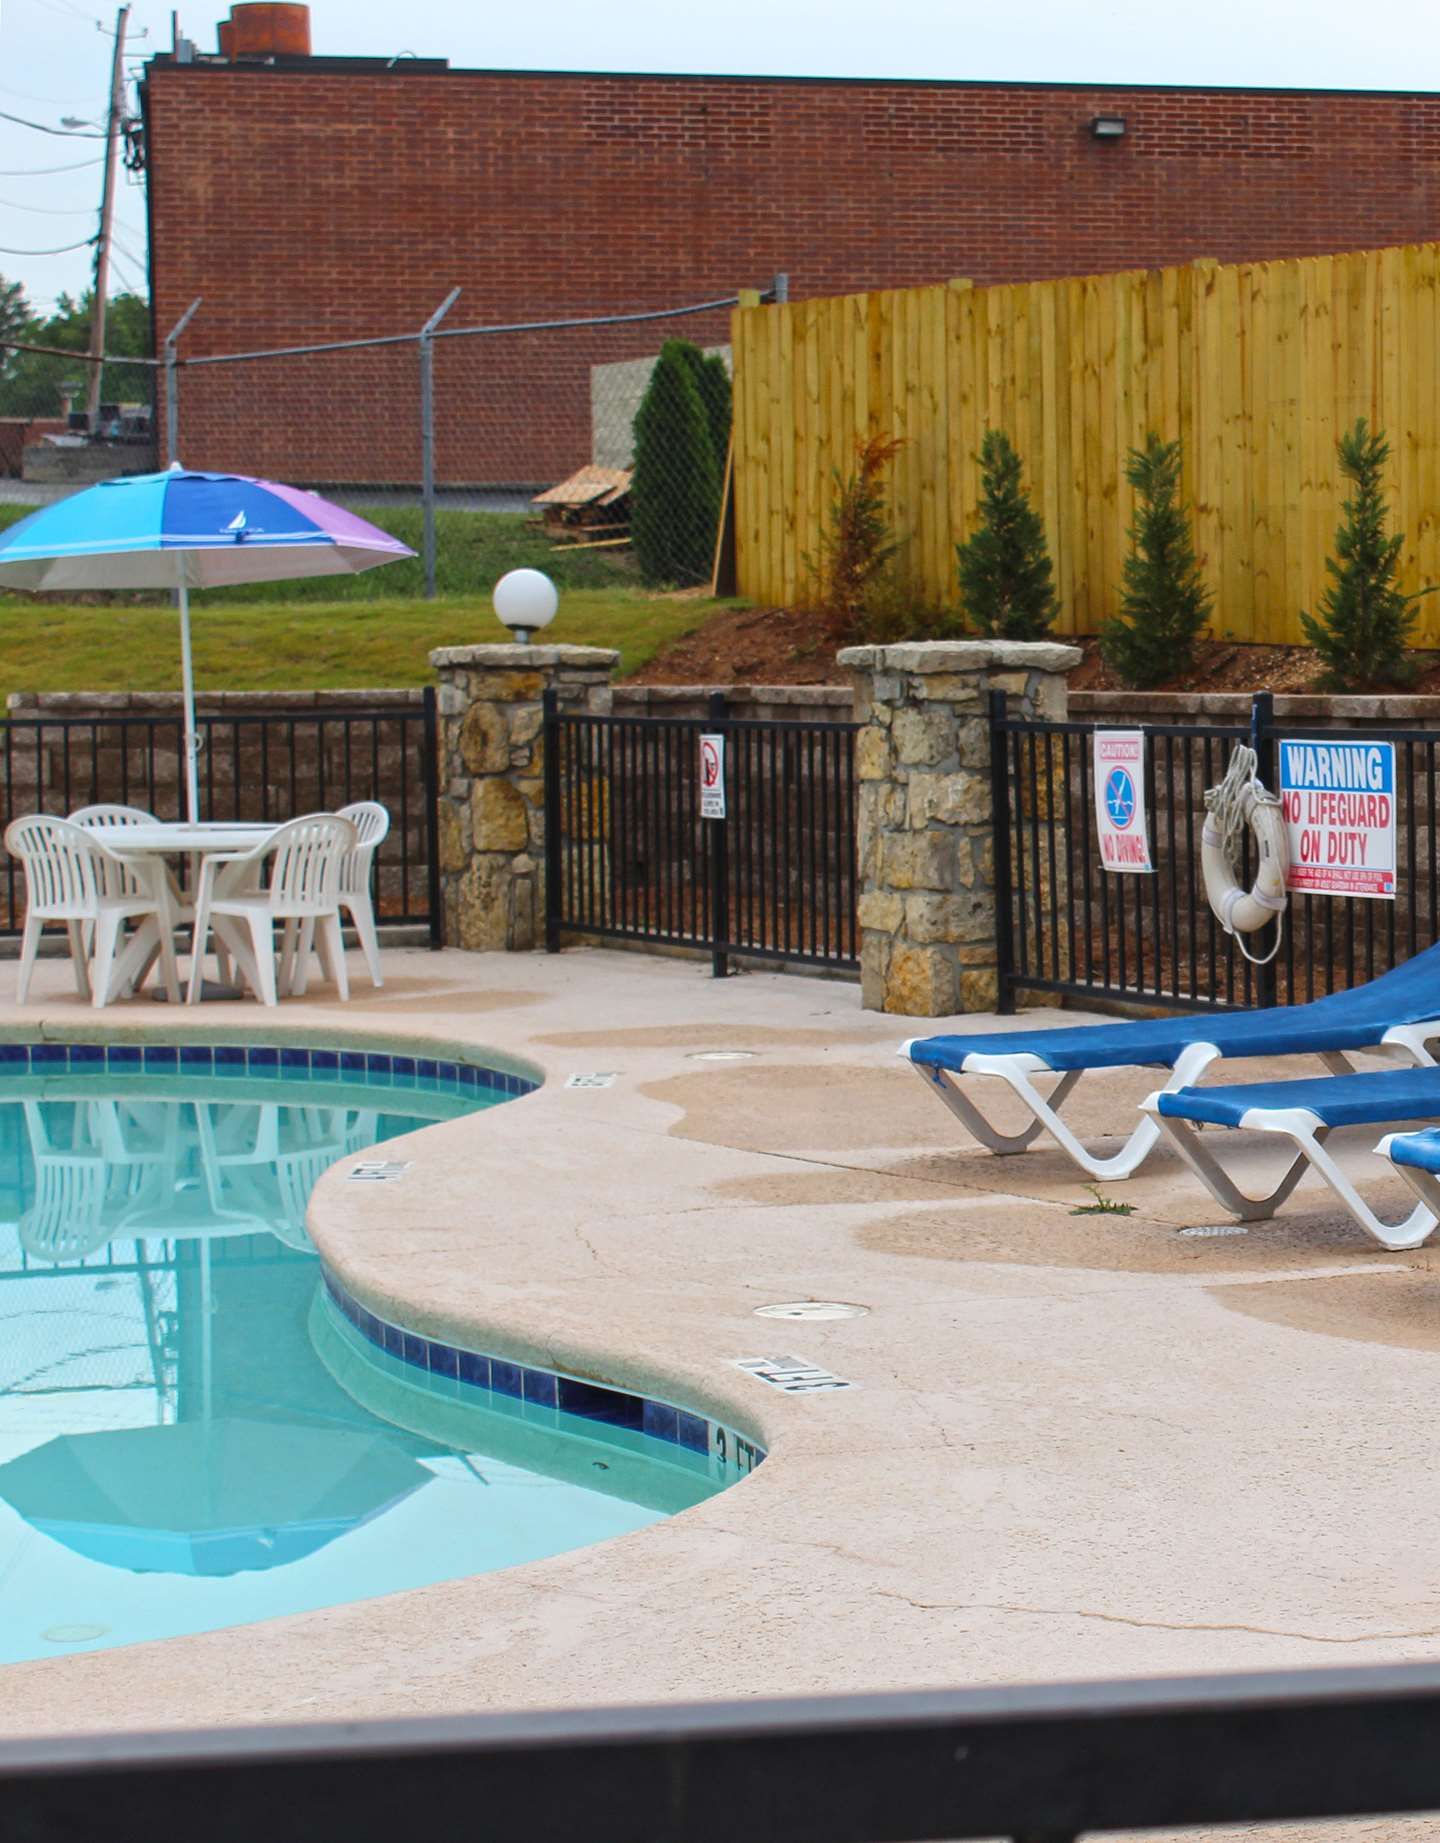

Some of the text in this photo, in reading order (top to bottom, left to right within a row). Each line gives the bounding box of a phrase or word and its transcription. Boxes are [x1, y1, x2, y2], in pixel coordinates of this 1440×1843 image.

[1287, 745, 1382, 790] WARNING
[1282, 791, 1390, 829] NO LIFEGUARD
[1103, 833, 1115, 862] NO
[1300, 829, 1368, 866] ON DUTY
